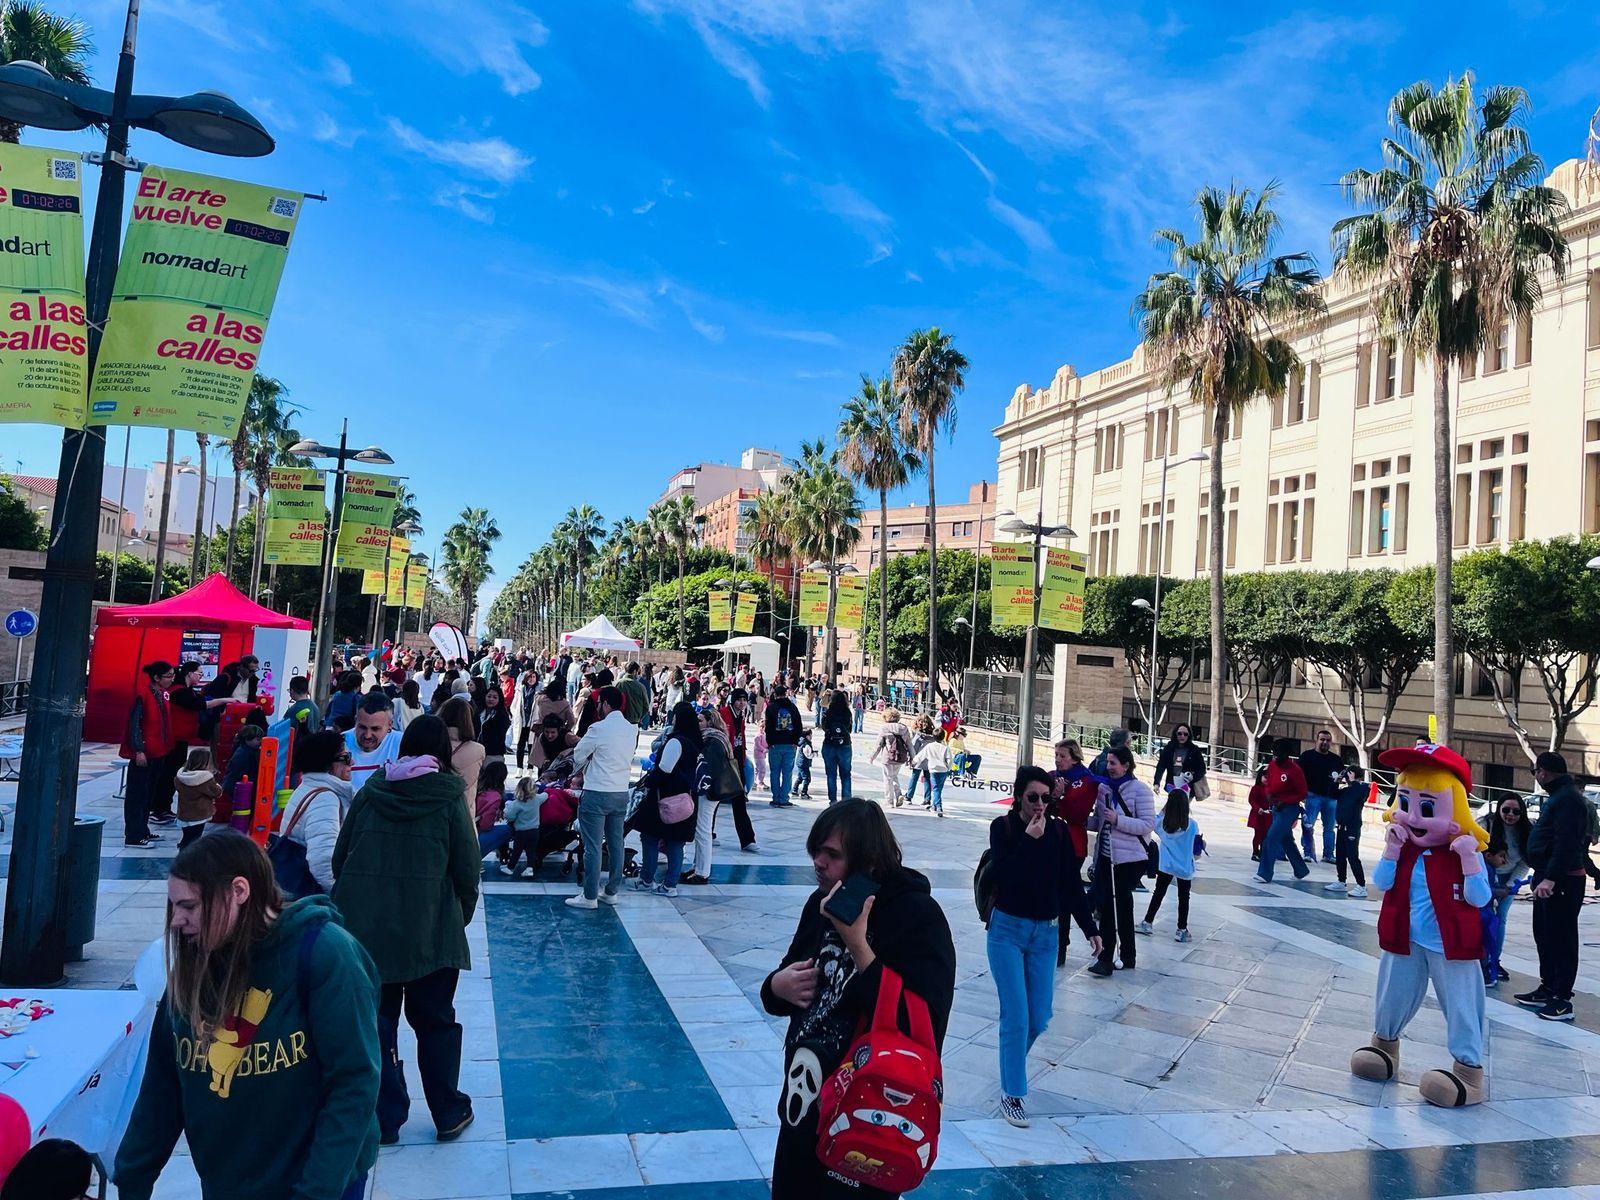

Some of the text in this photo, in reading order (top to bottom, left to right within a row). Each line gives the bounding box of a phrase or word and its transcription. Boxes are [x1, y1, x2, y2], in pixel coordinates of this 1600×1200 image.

[138, 176, 226, 208] El arte
[22, 194, 72, 208] 07:02:26
[133, 205, 222, 230] vuelve
[234, 222, 281, 242] 07:02:26
[142, 251, 248, 279] nomadart
[10, 296, 86, 326] a las
[186, 312, 263, 344] a las
[157, 338, 256, 370] calles
[194, 369, 216, 377] febrero
[35, 383, 59, 391] octubre
[229, 382, 242, 390] 20h
[186, 392, 210, 400] octubre
[224, 398, 238, 406] 20h
[270, 472, 280, 480] El
[347, 476, 374, 486] El arte
[270, 482, 302, 490] vuelve
[346, 486, 374, 495] vuelve
[348, 504, 384, 512] nomadart
[308, 521, 324, 530] las
[290, 531, 322, 540] calles
[374, 526, 390, 536] las
[356, 536, 388, 546] calles
[1055, 552, 1070, 560] arte
[1022, 588, 1033, 596] las
[1010, 596, 1033, 604] calles
[1072, 594, 1082, 604] las
[952, 777, 984, 790] Cruz
[236, 1031, 308, 1076] BEAR
